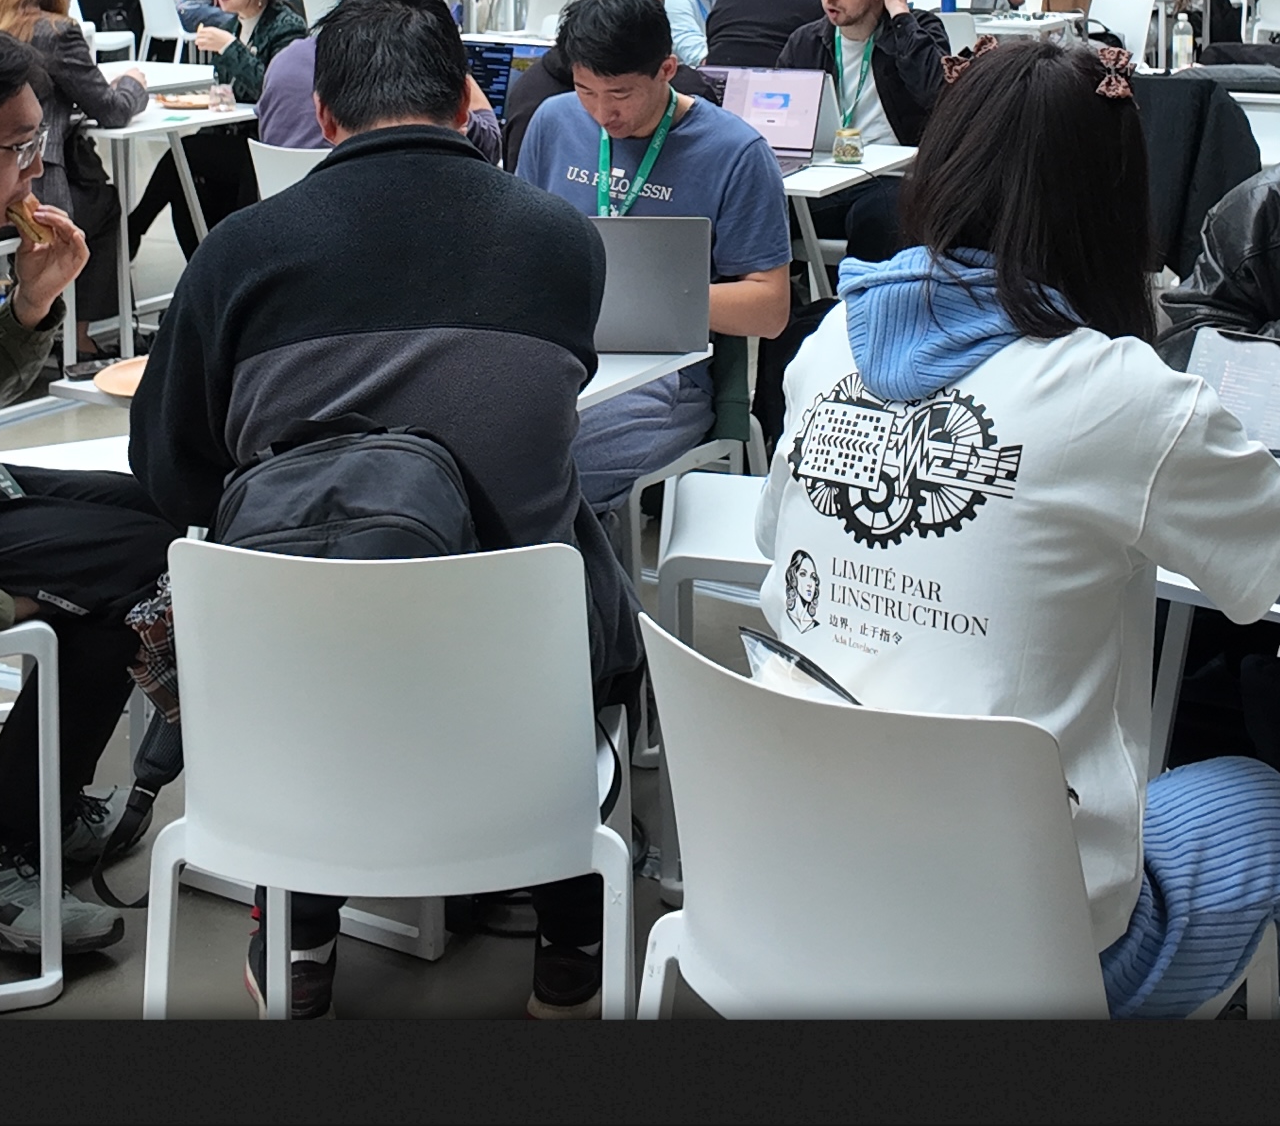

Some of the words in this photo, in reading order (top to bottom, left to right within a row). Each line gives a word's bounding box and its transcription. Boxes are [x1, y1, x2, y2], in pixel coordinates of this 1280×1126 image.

[566, 166, 590, 185] U.S.
[591, 174, 630, 193] PLO
[637, 183, 673, 202] SSN.
[831, 557, 896, 592] LIMITÉ
[901, 574, 942, 603] PAR
[830, 583, 989, 637] L'INSTRUCTION
[832, 633, 848, 647] Ada
